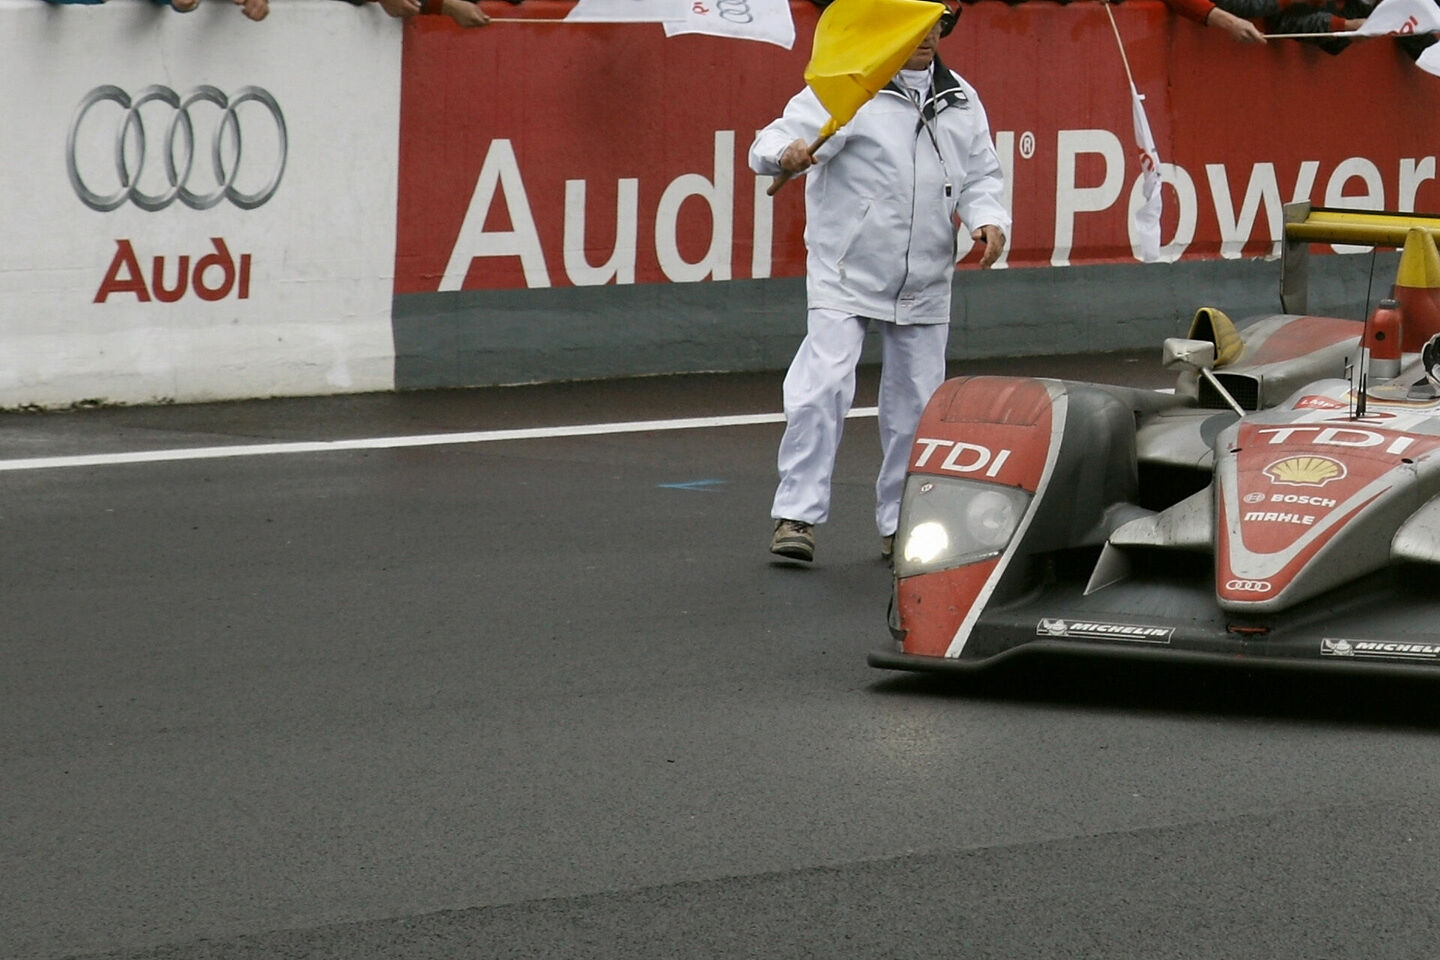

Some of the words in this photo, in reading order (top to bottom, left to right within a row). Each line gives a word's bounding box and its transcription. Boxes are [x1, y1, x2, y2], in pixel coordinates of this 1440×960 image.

[437, 130, 774, 292] Audi
[1050, 129, 1436, 268] Power
[92, 237, 252, 304] Audi
[1257, 426, 1415, 455] TDI
[915, 437, 1012, 478] TDI
[1270, 493, 1336, 508] BOSCH
[1244, 511, 1316, 526] MAHLE
[1069, 622, 1170, 636] MICHELIN
